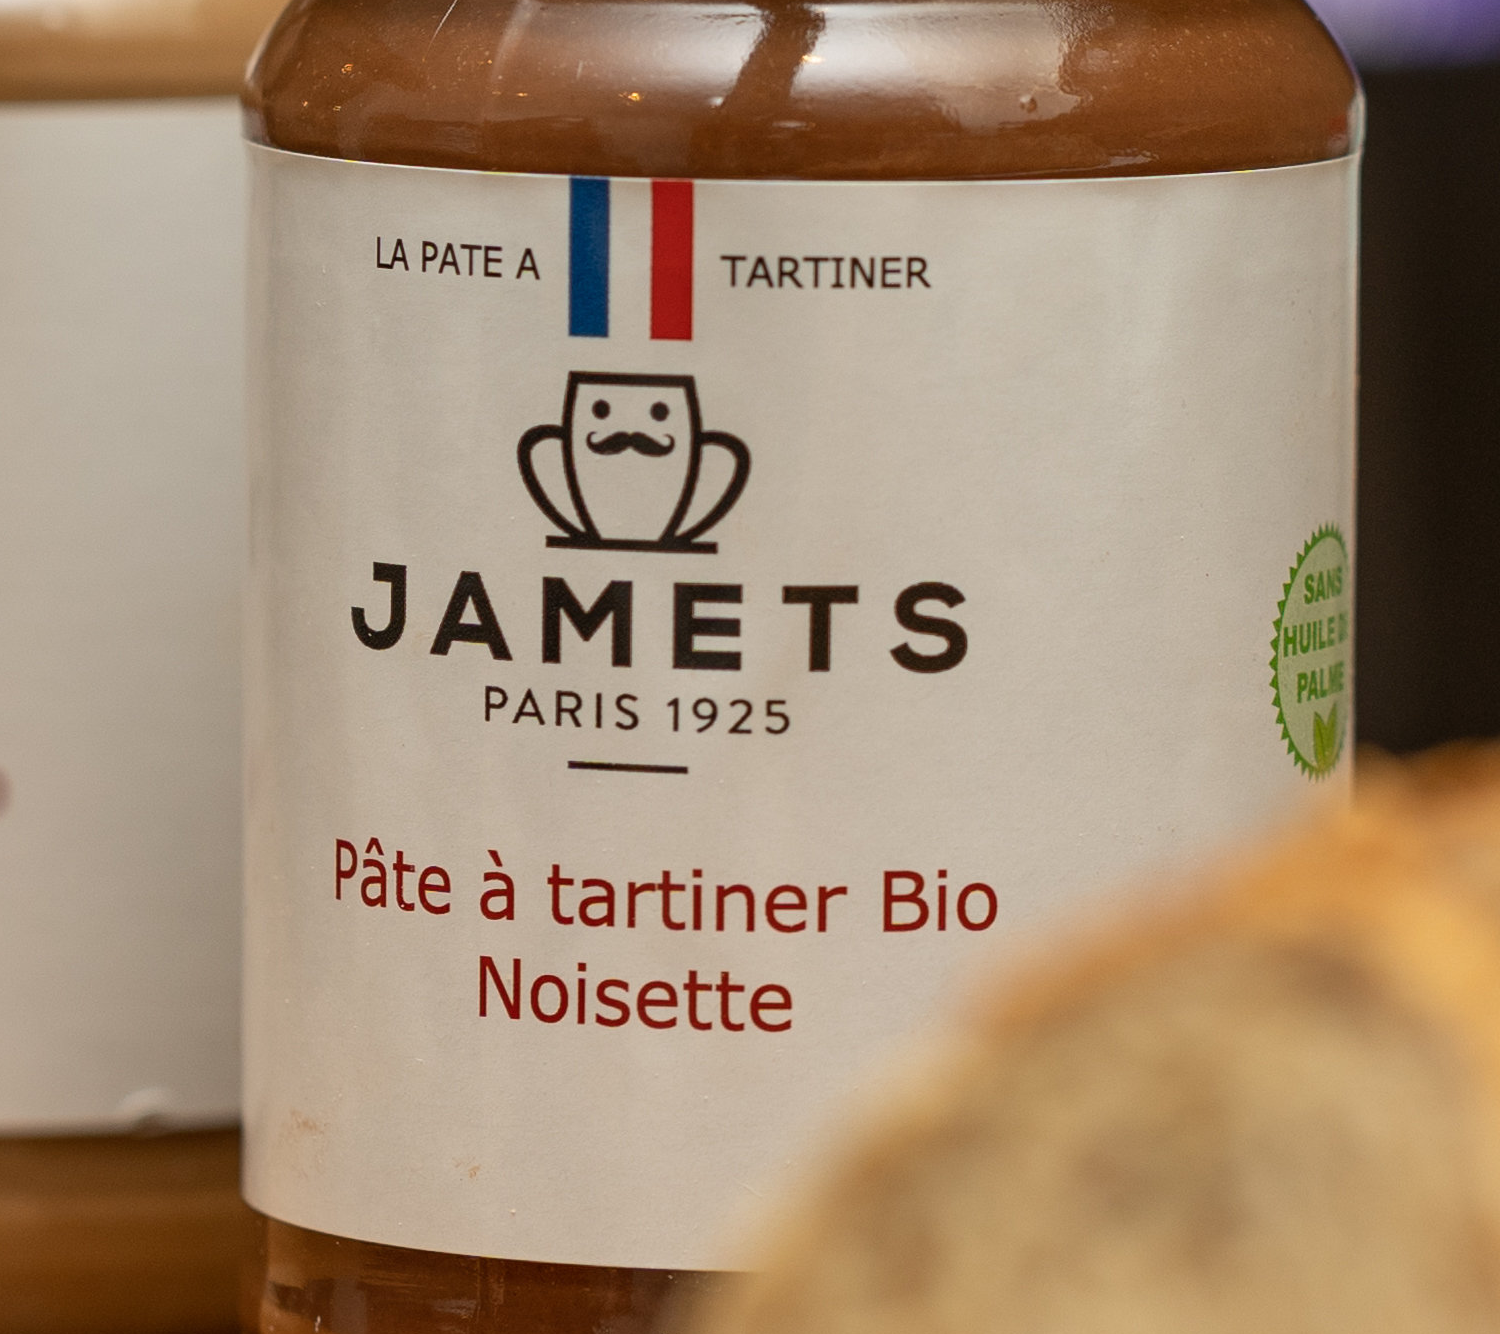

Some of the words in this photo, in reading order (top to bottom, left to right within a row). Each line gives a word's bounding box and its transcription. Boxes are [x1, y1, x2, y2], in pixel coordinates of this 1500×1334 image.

[376, 235, 411, 272] LA
[421, 240, 505, 280] PATE
[515, 247, 542, 281] A
[719, 254, 933, 292] TARTINER
[1303, 567, 1343, 605] SANS
[350, 560, 970, 676] JAMETS
[1283, 616, 1336, 658] HUILE
[1297, 661, 1345, 703] PALME
[484, 684, 641, 733] PARIS
[666, 695, 793, 737] 1925
[334, 836, 453, 916] Pâte
[479, 849, 518, 922] à
[546, 863, 849, 936] tartiner
[881, 867, 1001, 935] Bio
[477, 955, 795, 1034] Noisette
